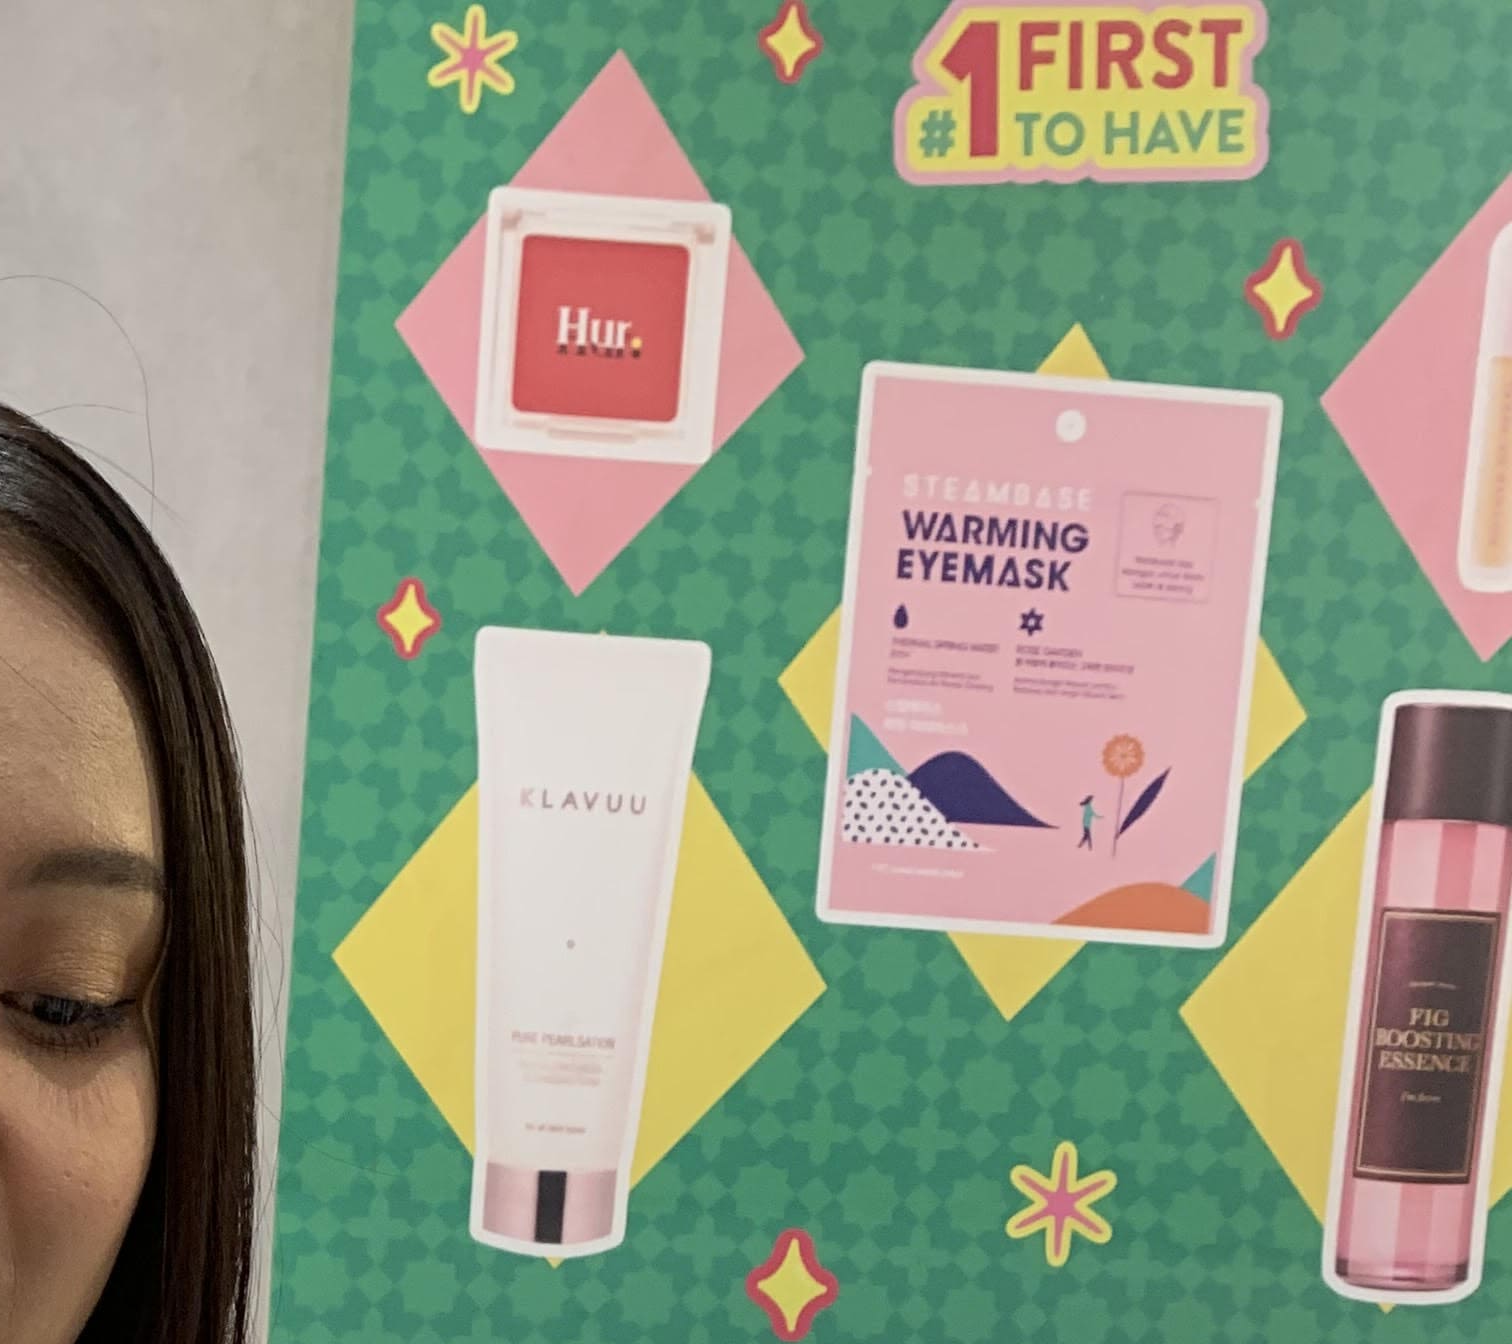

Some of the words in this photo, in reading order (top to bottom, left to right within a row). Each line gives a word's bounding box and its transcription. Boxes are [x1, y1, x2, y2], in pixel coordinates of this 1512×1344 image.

[919, 20, 999, 158] #1
[1019, 19, 1243, 91] FIRST
[1015, 111, 1085, 156] TO
[1104, 108, 1245, 155] HAVE
[556, 305, 643, 350] Hur.
[902, 473, 1092, 512] STEAMBASE
[901, 508, 1090, 553] WARMING
[896, 547, 1071, 592] EYEMASK
[519, 787, 647, 816] KLAVUU
[1409, 1007, 1450, 1027] FIG
[1375, 1027, 1483, 1050] BOOSTING
[1378, 1049, 1470, 1073] ESSENCE
